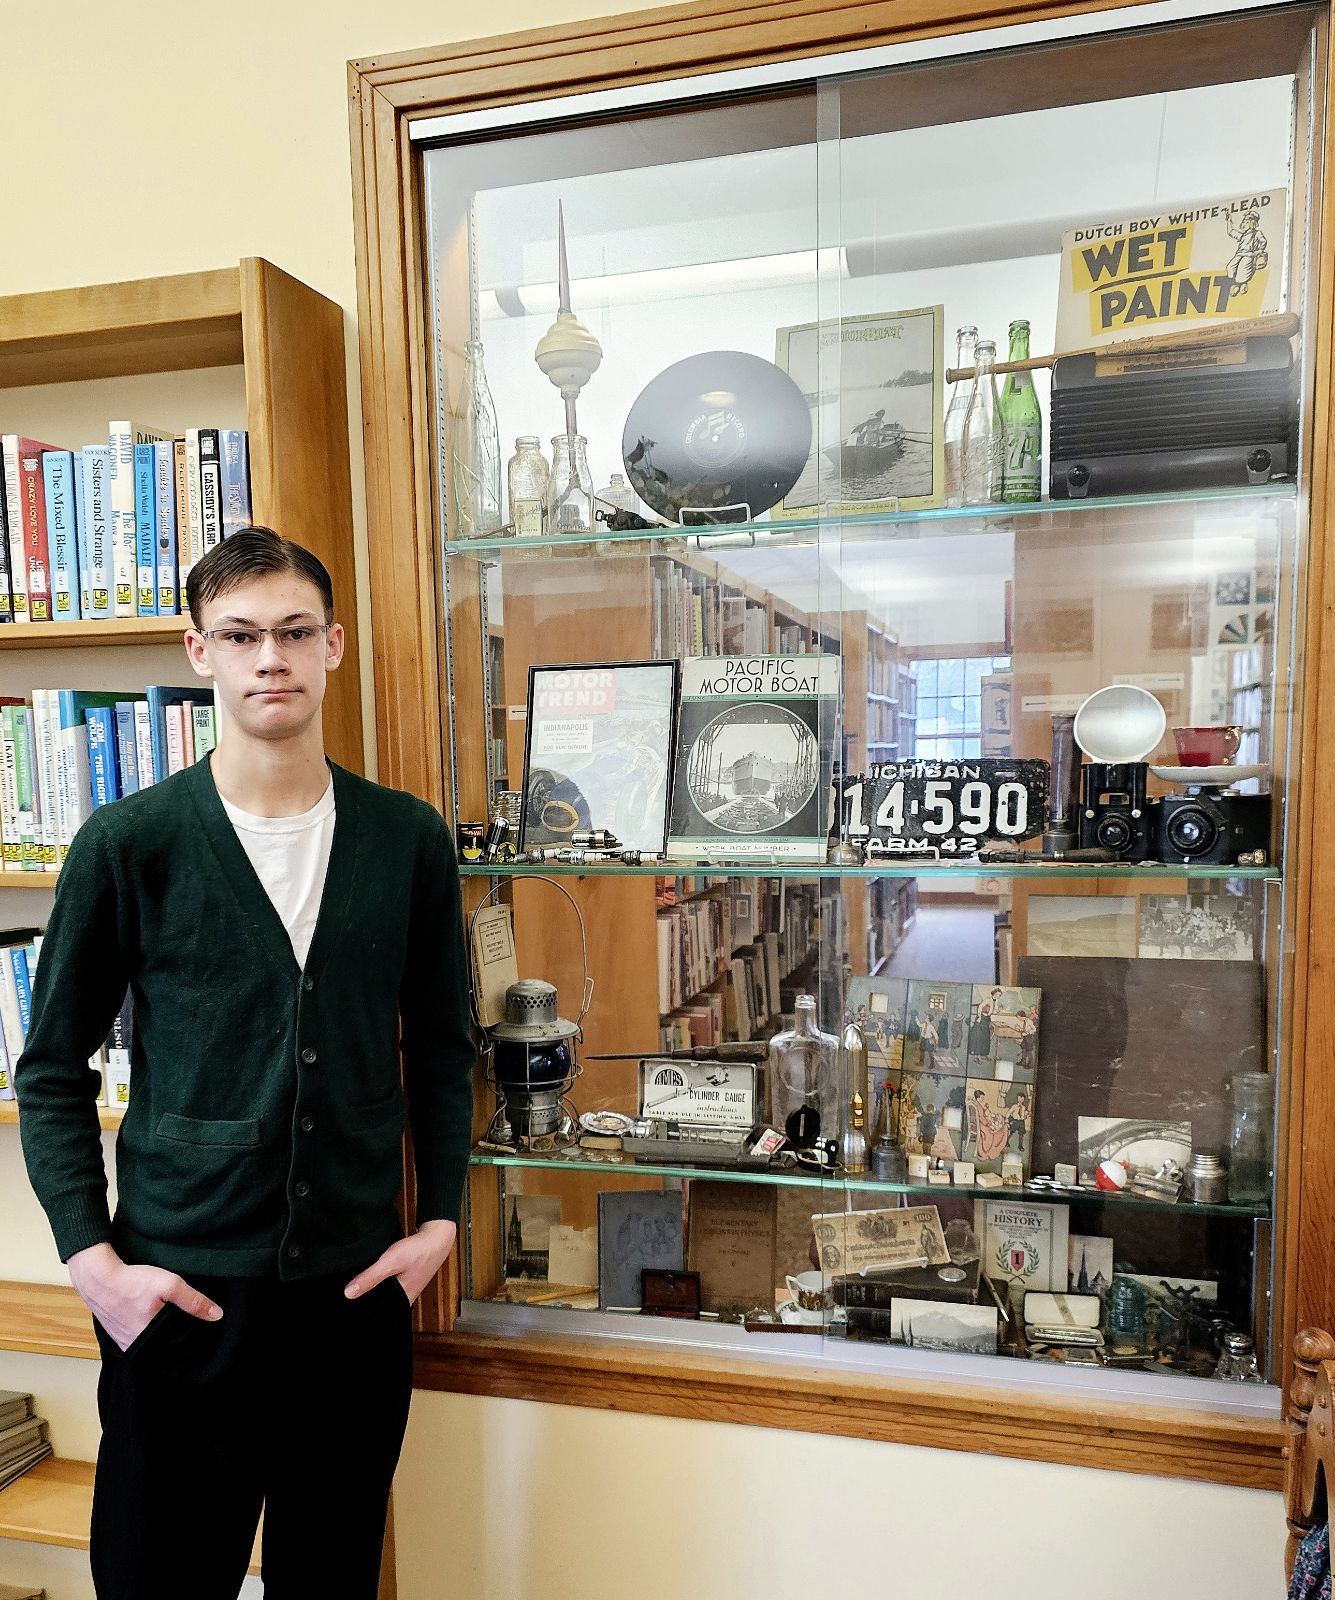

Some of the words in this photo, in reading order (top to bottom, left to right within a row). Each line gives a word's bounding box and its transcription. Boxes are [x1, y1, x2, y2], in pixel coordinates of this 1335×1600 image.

[1075, 224, 1122, 242] DUTCH
[1130, 218, 1160, 233] BOY
[1081, 227, 1187, 282] WET
[1100, 276, 1235, 328] PAINT
[119, 434, 132, 464] DAVID
[51, 465, 63, 489] The
[92, 459, 104, 496] Sisters
[140, 472, 148, 494] Sheila
[160, 457, 170, 491] Trouble
[27, 476, 36, 503] CRAZY
[161, 494, 169, 503] in
[204, 473, 215, 519] CASSIDY'S
[29, 505, 37, 527] LOVE
[54, 492, 66, 530] Mixed
[93, 500, 104, 520] and
[140, 495, 149, 516] Walsh
[160, 507, 171, 538] Spades
[31, 529, 39, 546] YOU
[55, 534, 66, 572] Blessin
[57, 593, 68, 601] LP
[95, 590, 107, 600] LP
[118, 585, 130, 594] LP
[141, 589, 152, 597] LP
[161, 588, 173, 597] LP
[34, 602, 44, 610] LP
[725, 660, 795, 676] PACIFIC
[536, 672, 613, 689] MOTOR
[700, 678, 762, 694] MOTOR
[772, 677, 818, 692] BOAT
[536, 690, 607, 707] TREND
[89, 716, 98, 749] WOLFE
[97, 722, 105, 744] TOM
[543, 723, 588, 732] INDIANAPOLIS
[5, 745, 14, 770] KATY
[95, 754, 104, 775] THE
[96, 777, 106, 805] RIGHT
[942, 838, 977, 851] 42
[689, 1089, 720, 1102] CYLINDER
[725, 1091, 746, 1103] GAUGE
[994, 1214, 1043, 1226] HISTORY
